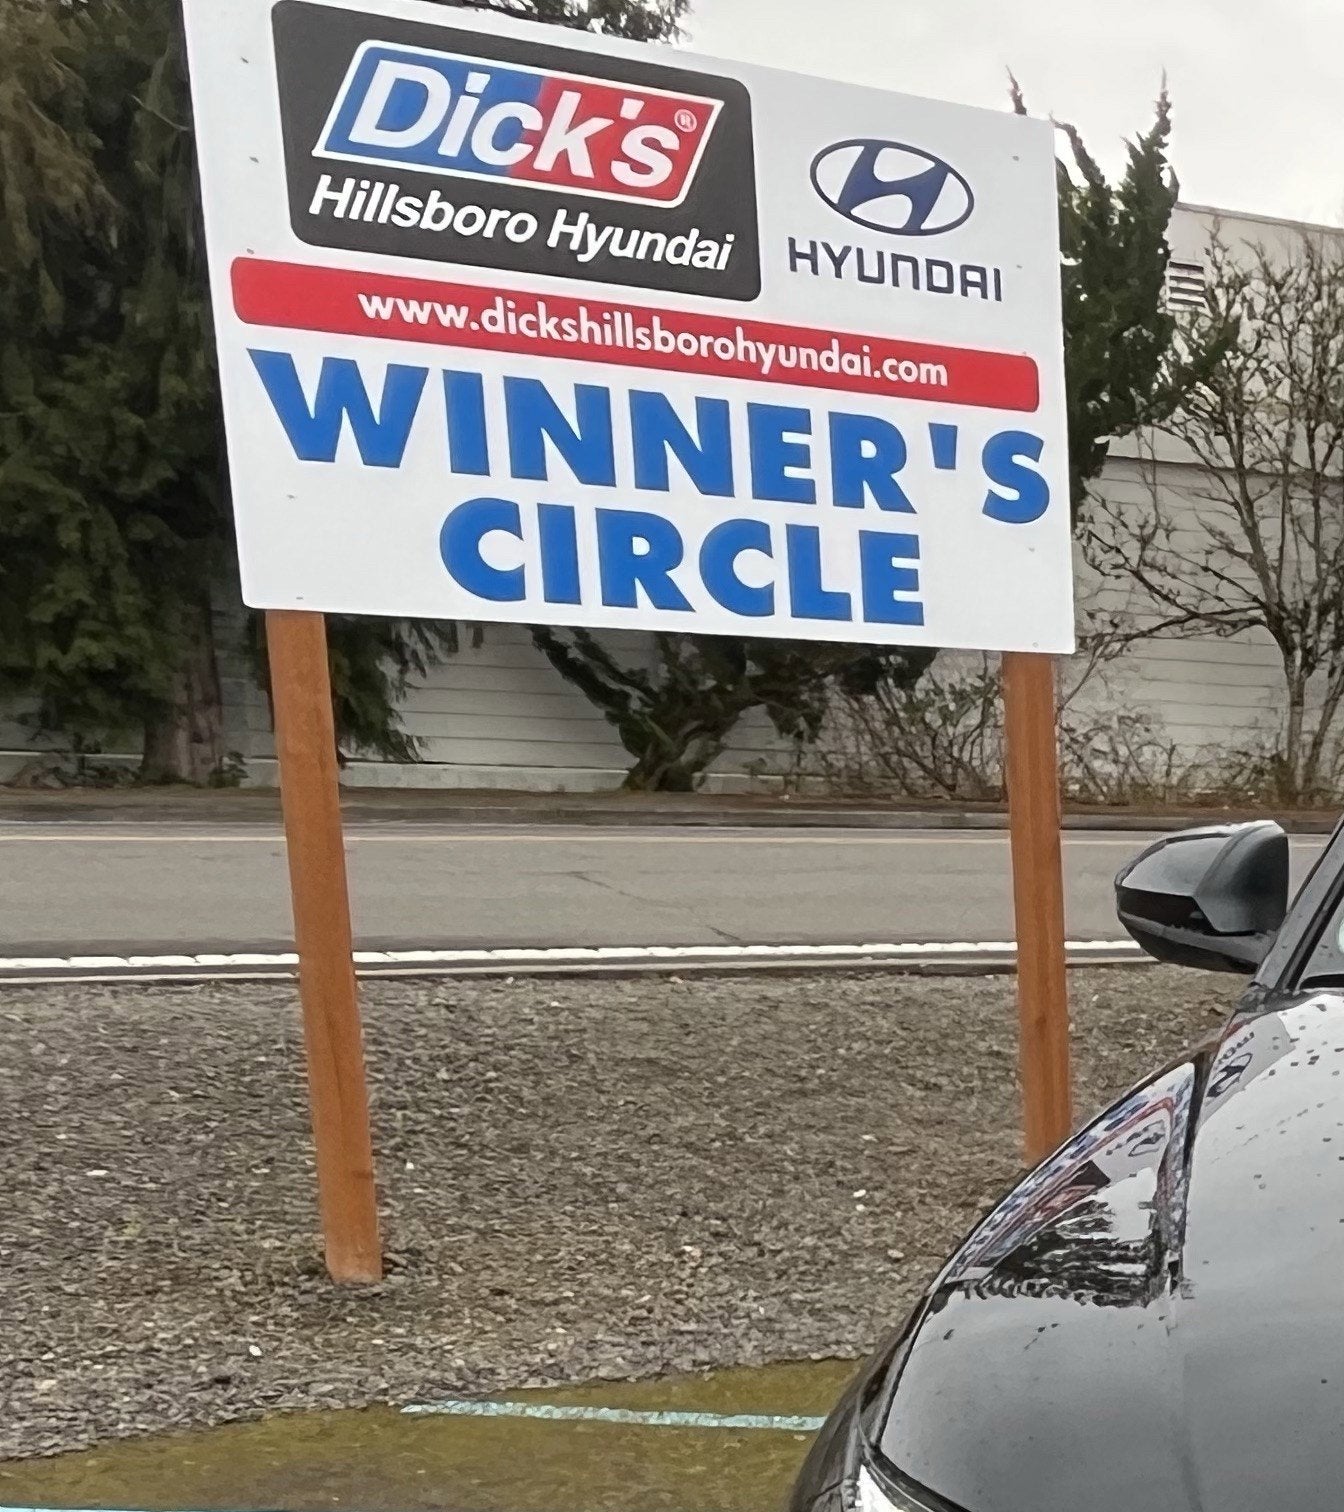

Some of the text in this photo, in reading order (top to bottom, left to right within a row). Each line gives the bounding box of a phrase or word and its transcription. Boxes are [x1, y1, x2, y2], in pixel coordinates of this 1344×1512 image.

[348, 59, 680, 188] Dick's
[309, 174, 735, 271] Hillsboro Hyundai
[788, 236, 1002, 302] HYUNDAI
[357, 293, 949, 387] www.dickshillsborohyundai.com
[246, 348, 1051, 525] WINNER'S
[439, 497, 925, 627] CIRCLE
